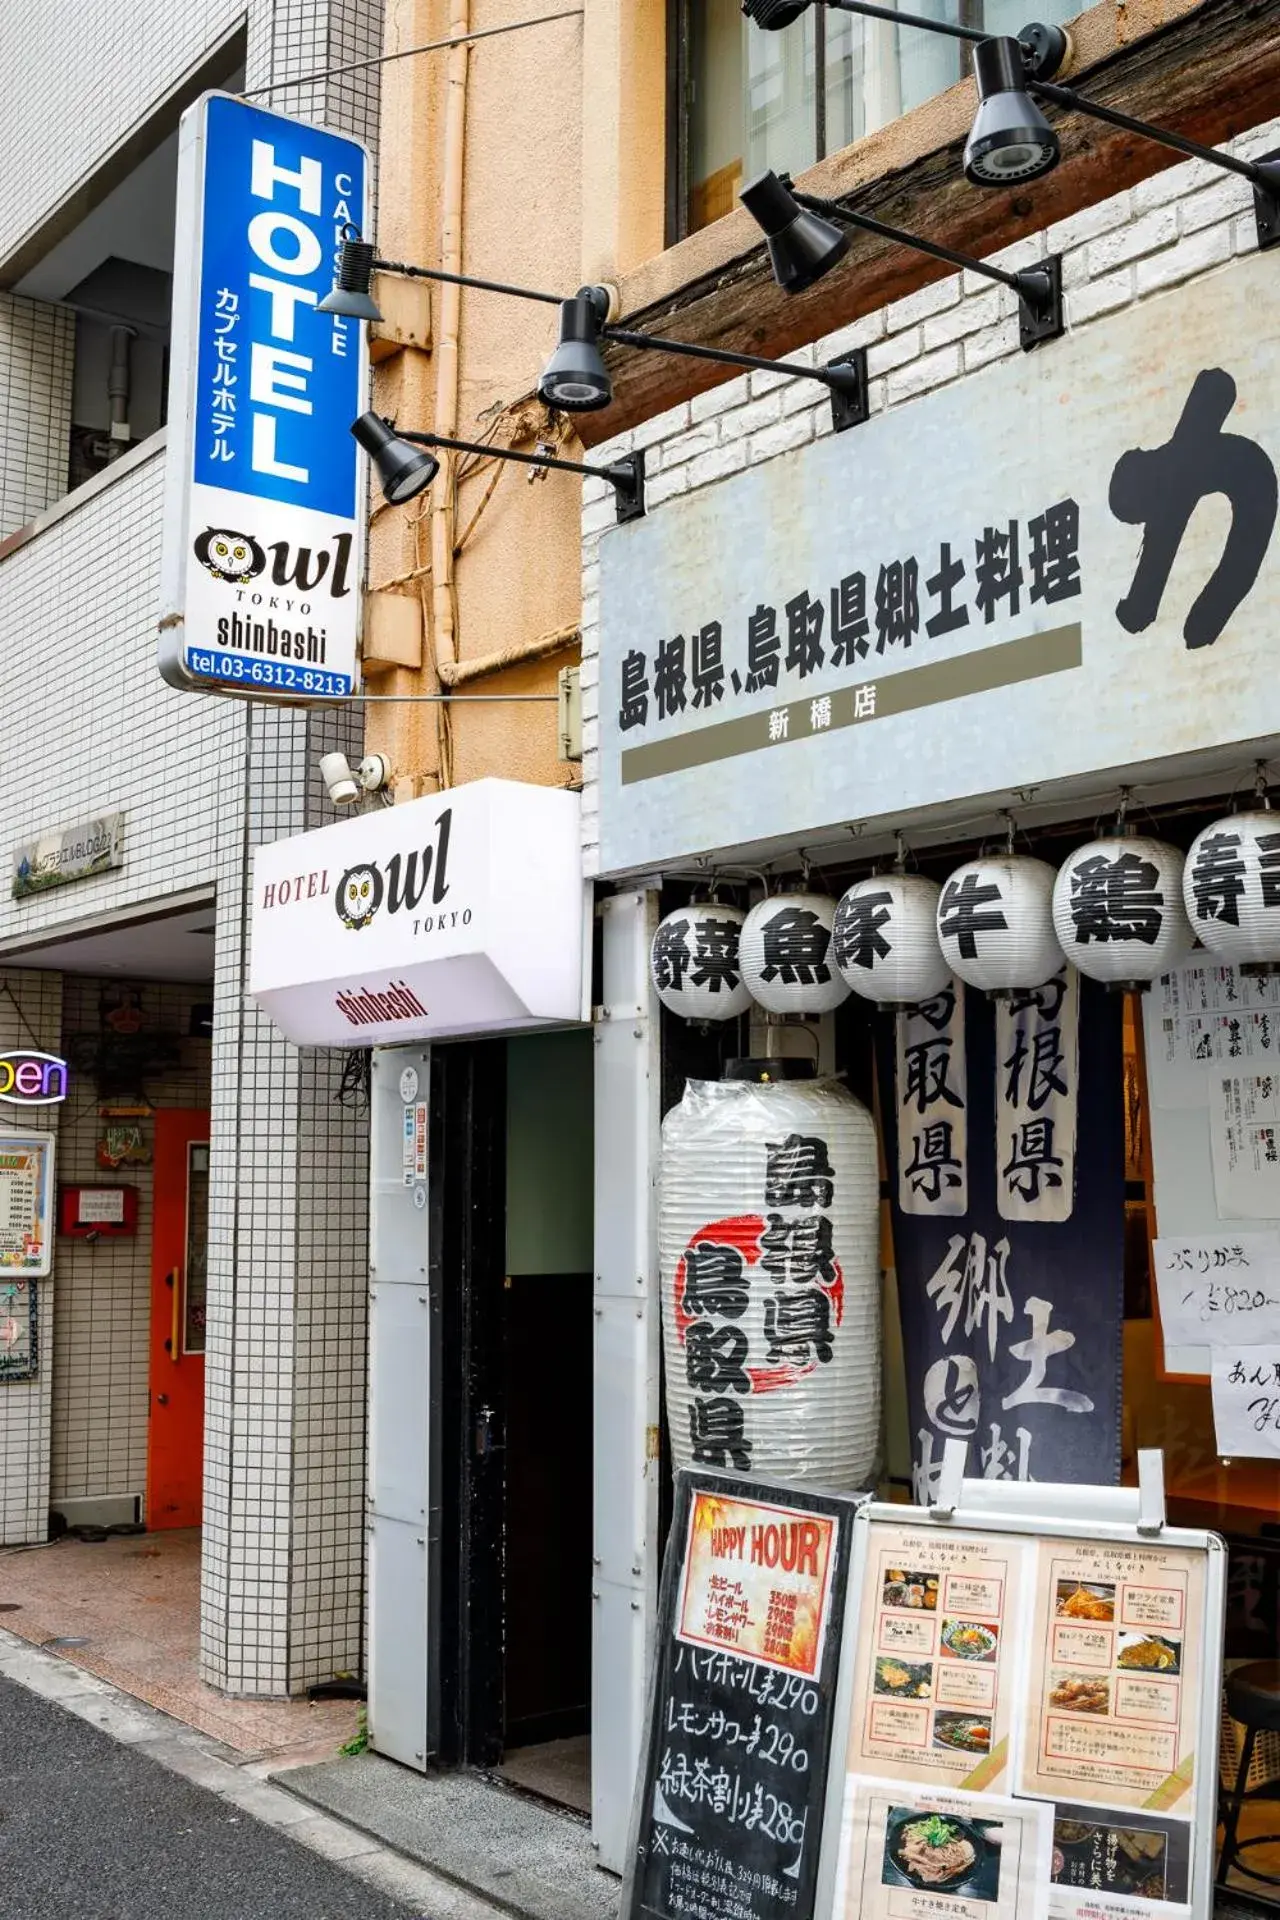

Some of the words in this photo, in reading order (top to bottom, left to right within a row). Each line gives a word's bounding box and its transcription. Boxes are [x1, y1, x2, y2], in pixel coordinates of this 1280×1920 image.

[247, 138, 323, 484] HOTEL
[209, 287, 241, 464] カプセルホテル
[193, 525, 354, 599] Owl
[216, 610, 327, 665] shinbashi
[235, 588, 312, 617] TOKYO
[262, 869, 331, 910] HOTEL
[335, 806, 453, 931] Owl
[411, 908, 473, 936] TOKYO
[759, 906, 833, 986] 魚
[832, 891, 894, 971] 豚
[939, 872, 1009, 960] 牛
[652, 917, 742, 993] 野菜
[335, 979, 430, 1027] shinbashi
[710, 1525, 747, 1561] HAPPY
[750, 1521, 821, 1578] HOUR
